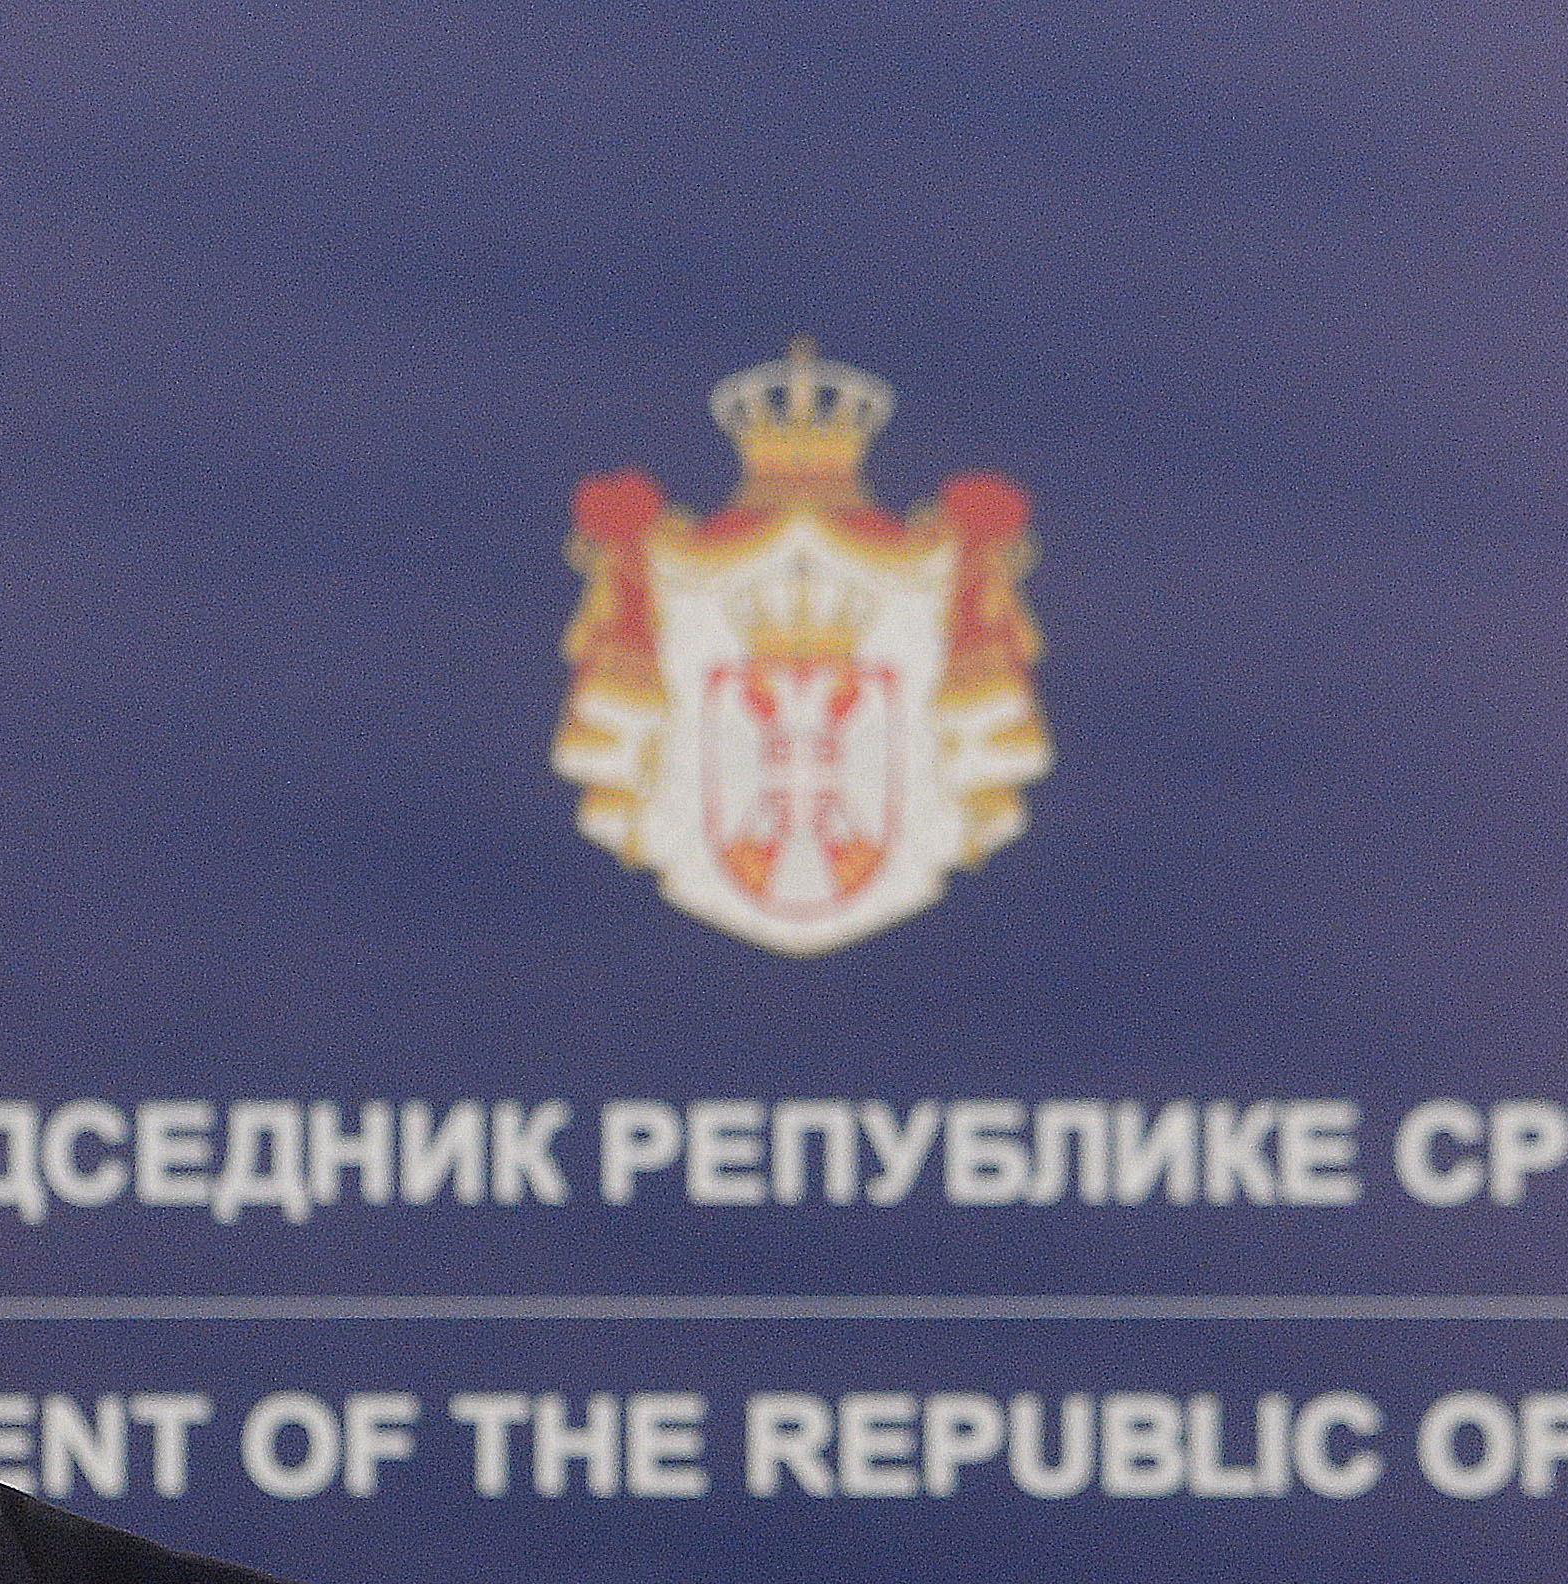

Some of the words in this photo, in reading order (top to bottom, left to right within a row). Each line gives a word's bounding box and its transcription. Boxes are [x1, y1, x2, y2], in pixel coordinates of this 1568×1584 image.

[600, 1099, 1360, 1205] РЕПУБЛИКЕ
[240, 1391, 418, 1498] OF
[450, 1393, 707, 1497] THE
[746, 1391, 1382, 1498] REPUBLIC
